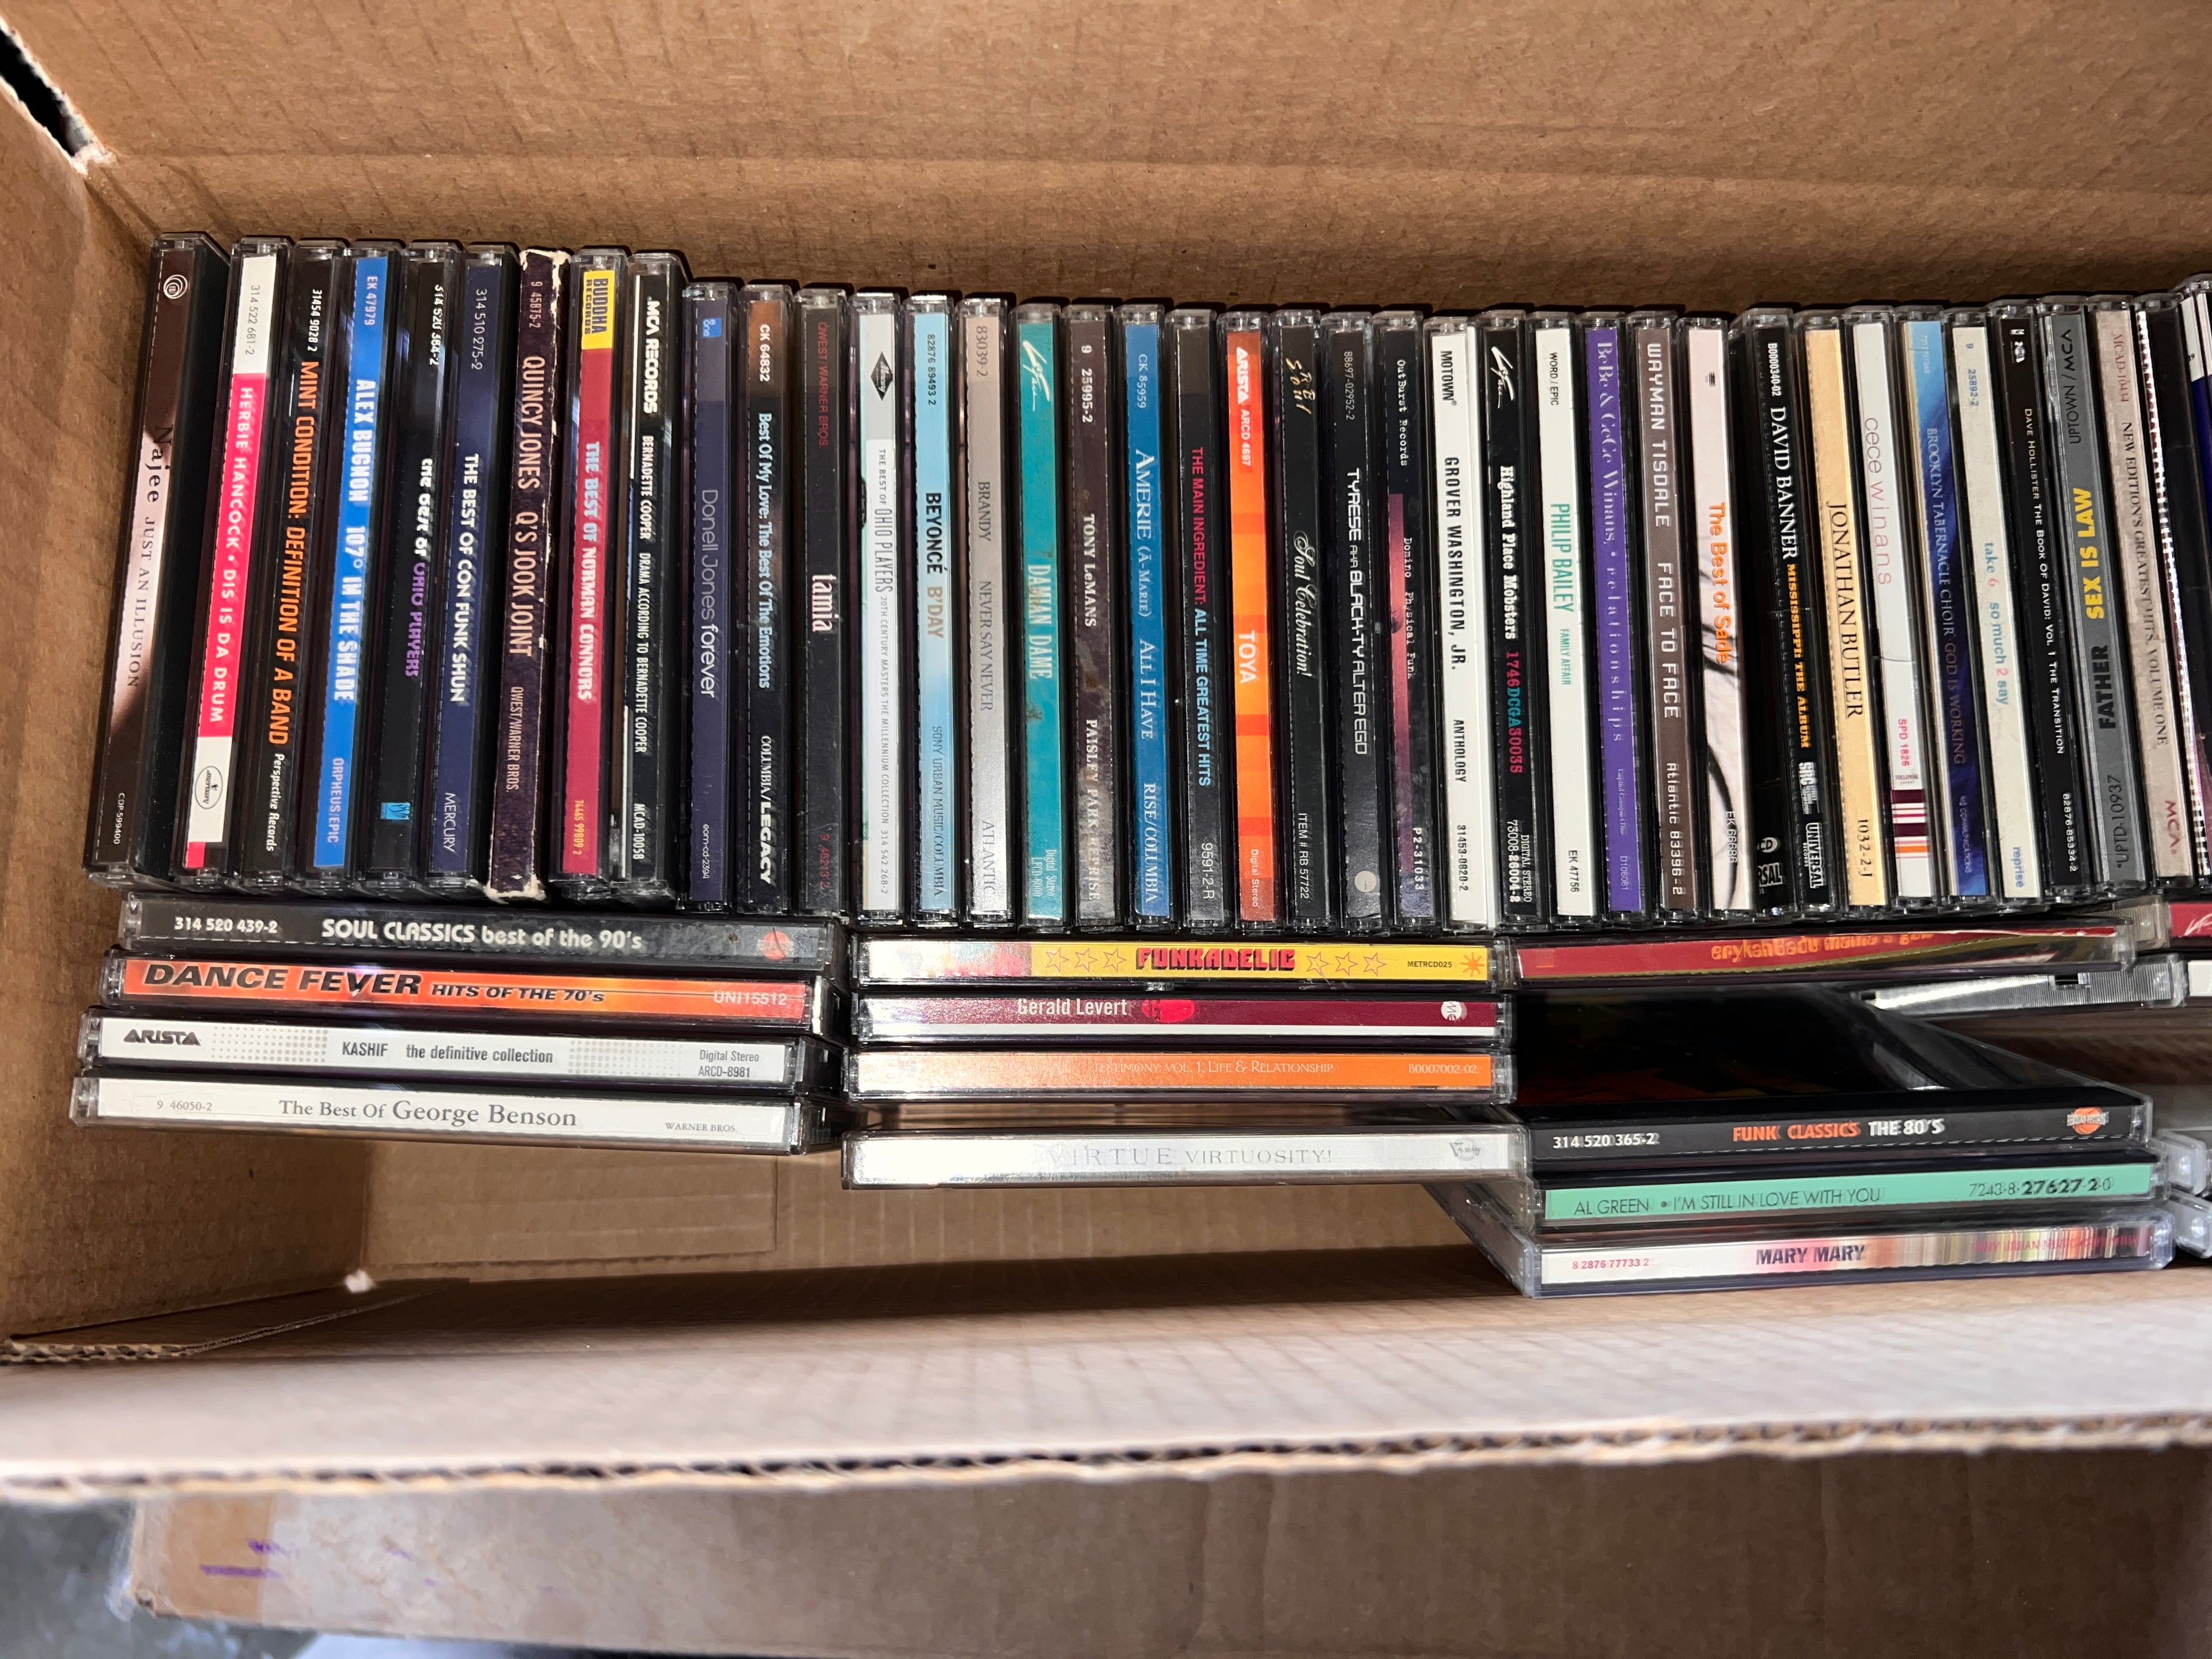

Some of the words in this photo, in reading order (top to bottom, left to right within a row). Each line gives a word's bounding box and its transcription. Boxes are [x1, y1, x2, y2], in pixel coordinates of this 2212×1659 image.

[592, 278, 609, 335] BUDDHA
[759, 344, 770, 382] 64832
[975, 325, 988, 377] 83039-2
[2061, 329, 2074, 371] MCA
[298, 361, 319, 409] MINT
[522, 357, 546, 426] QUINCY
[927, 366, 936, 397] 89493
[1081, 368, 1093, 423] 25995-2
[1136, 374, 1149, 409] 85959
[1236, 347, 1249, 405] ARISTA
[1343, 351, 1355, 421] 88697-02952-2
[1441, 350, 1455, 402] MOTOWN
[1647, 343, 1665, 430] WAYMAN
[236, 388, 253, 449] HERBIE
[353, 380, 376, 425] ALEX
[2063, 385, 2081, 444] UPTOWN
[517, 431, 543, 489] JONES
[585, 441, 600, 472] THE
[1241, 442, 1252, 466] 4697
[1769, 407, 1791, 470] DAVID
[1864, 418, 1882, 474] cece
[1926, 427, 1943, 498] BROOKLYN
[145, 425, 174, 502] Najee
[288, 416, 315, 519] CONDITION:
[348, 430, 373, 502] BUGNON
[463, 454, 479, 484] THE
[641, 435, 655, 497] BERNADETTE
[1444, 457, 1461, 517] GROVER
[1652, 440, 1671, 528] TISDALE
[226, 457, 251, 548] HANCOCK
[461, 489, 476, 527] BEST
[584, 478, 599, 517] BEST
[639, 499, 654, 539] COOPER
[701, 489, 719, 550] Donell
[978, 481, 991, 541] BRANDY
[1347, 468, 1361, 542] TYRESE
[1497, 465, 1514, 528] Highland
[1709, 501, 1726, 536] The
[1775, 476, 1798, 560] BANNER
[2073, 488, 2096, 537] LAW
[141, 517, 157, 560] JUST
[459, 533, 474, 555] OF
[583, 522, 598, 543] OF
[874, 508, 892, 537] OHIO
[926, 493, 948, 575] BEYONCÉ
[1083, 514, 1096, 558] TONY
[1550, 504, 1571, 553] PHILIP
[1870, 481, 1893, 585] winans
[512, 548, 535, 597] JOOK
[637, 552, 651, 585] DRAMA
[874, 542, 893, 593] PLAYERS
[1502, 533, 1516, 570] Place
[1710, 542, 1729, 587] Best
[1983, 543, 1998, 574] take
[2080, 547, 2099, 567] IS
[137, 568, 150, 592] AN
[222, 569, 237, 599] DIS
[277, 527, 306, 631] DEFINITION
[342, 577, 362, 596] IN
[456, 559, 473, 597] CON
[580, 548, 597, 619] NORMAN
[700, 555, 718, 621] Jones
[1027, 565, 1052, 625] DAMIAN
[1084, 563, 1097, 627] LeMANS
[1446, 525, 1464, 635] WASHINGTON,
[1552, 559, 1574, 613] BAILEY
[1657, 563, 1675, 618] FACE
[1714, 590, 1731, 611] of
[2083, 577, 2104, 620] SEX
[339, 601, 361, 634] THE
[453, 603, 469, 649] FUNK
[810, 574, 839, 632] tamia
[978, 581, 992, 629] NEVER
[1503, 575, 1518, 640] Mobsters
[127, 600, 147, 687] ILLUSION
[215, 633, 232, 658] DA
[276, 639, 296, 662] OF
[509, 603, 533, 657] JOINT
[1294, 584, 1317, 676] Celebration!
[1660, 628, 1676, 653] TO
[1714, 616, 1733, 664] Sade
[1991, 624, 2007, 665] much
[274, 668, 294, 681] A
[334, 641, 358, 701] SHADE
[450, 653, 467, 702] SHUN
[577, 624, 594, 700] CONNORS
[700, 624, 718, 698] forever
[757, 627, 772, 689] Emotions
[880, 658, 889, 698] MASTERS
[1028, 635, 1052, 679] DAME
[1238, 630, 1256, 684] TOYA
[1451, 644, 1466, 671] JR.
[210, 668, 229, 722] DRUM
[1351, 660, 1366, 716] ALTER
[1662, 663, 1680, 719] FACE
[1826, 502, 1856, 627] JONATHAN
[1841, 632, 1863, 719] BUTLER
[1857, 819, 1873, 878] 1032-2-J
[1994, 680, 2010, 705] say
[2090, 645, 2116, 730] FATHER
[268, 689, 292, 745] BAND
[1195, 676, 1210, 751] GREATEST
[1796, 696, 1810, 748] ALBUM
[1198, 753, 1210, 786] HITS
[1452, 719, 1466, 783] ANTHOLOGY
[1900, 744, 1911, 767] 1826
[442, 793, 457, 853] MERCURY
[632, 804, 646, 860] MCAD-10058
[758, 736, 772, 884] COLUMBIA/LEGACY
[2062, 793, 2076, 873] 82876-85334-2
[2163, 800, 2180, 849] MCA
[1143, 783, 1159, 903] RISE/COLUMBIA
[1412, 827, 1425, 891] P2-31033
[1726, 829, 1738, 863] 66686
[1200, 842, 1214, 900] 9591-2-R
[1298, 868, 1309, 899] 57722
[1521, 870, 1532, 902] STEREO
[1569, 866, 1580, 893] 47756
[321, 918, 378, 940] SOUL
[383, 921, 475, 943] CLASSICS
[481, 925, 528, 946] best
[532, 927, 555, 946] of
[559, 928, 593, 948] the
[599, 929, 642, 950] 90's
[1135, 946, 1296, 972] FUNKADELIC
[1407, 960, 1453, 968] METRCD025
[144, 964, 289, 990] DANCE
[300, 970, 424, 995] FEVER
[431, 984, 479, 998] HITS
[713, 991, 789, 1006] UNI15512
[1017, 998, 1071, 1015] Gerald
[1077, 998, 1127, 1015] Levert
[342, 1042, 388, 1058] KASHIF
[430, 1045, 490, 1062] definitive
[493, 1048, 554, 1064] collection
[698, 1066, 751, 1078] ARCD-8981
[1408, 1063, 1477, 1074] B0007002-02
[279, 1099, 313, 1115] The
[319, 1101, 357, 1117] Best
[363, 1102, 388, 1119] Of
[392, 1100, 479, 1127] George
[488, 1103, 577, 1127] Benson
[1733, 1127, 1778, 1142] FUNK
[1787, 1122, 1859, 1141] CLASSICS
[1185, 1149, 1332, 1164] VIRTUOSITY!
[1597, 1198, 1649, 1214] GREEN
[1759, 1191, 1799, 1207] LOVE
[1847, 1188, 1881, 1203] YOU
[1609, 1258, 1641, 1268] 77733
[1756, 1248, 1807, 1266] MARY
[1813, 1245, 1865, 1263] MARY
